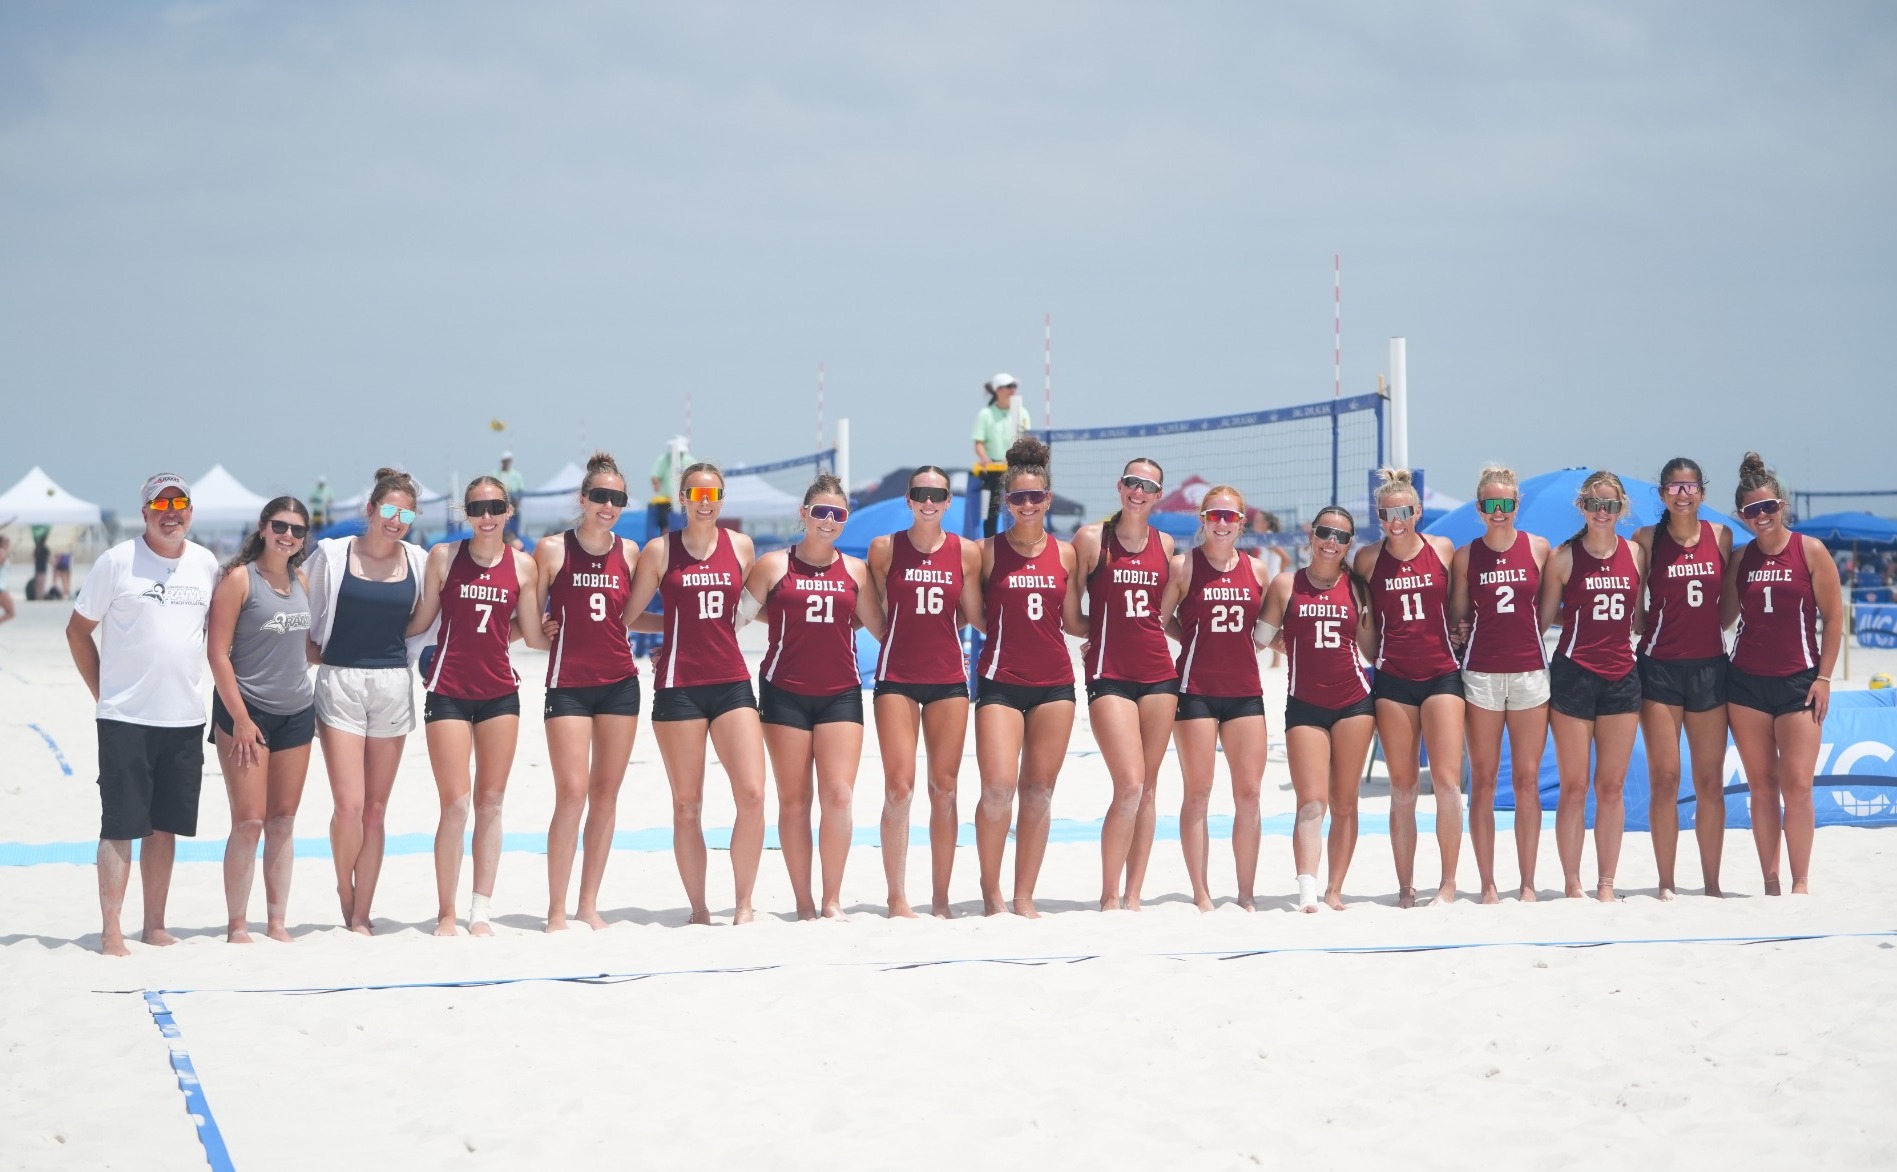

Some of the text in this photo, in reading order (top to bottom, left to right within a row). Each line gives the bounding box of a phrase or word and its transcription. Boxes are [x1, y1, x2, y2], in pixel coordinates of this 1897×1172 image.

[681, 573, 732, 586] MOBILE
[904, 569, 953, 584] MOBILE
[1113, 570, 1159, 585] MOBILE
[1479, 569, 1528, 585] MOBILE
[1667, 562, 1715, 577] MOBILE
[1746, 569, 1793, 582] MOBILE
[572, 573, 620, 589] MOBILE
[795, 579, 846, 592] MOBILE
[1007, 575, 1057, 588] MOBILE
[1384, 574, 1434, 590] MOBILE
[1584, 577, 1631, 590] MOBILE
[459, 584, 509, 603] MOBILE
[916, 587, 943, 614] 16
[1125, 590, 1150, 617] 12
[1202, 588, 1252, 600] MOBILE
[1496, 586, 1514, 613] 2
[1687, 580, 1703, 607] 6
[1763, 587, 1773, 612] 1
[590, 593, 606, 621] 9
[698, 591, 724, 619] 18
[806, 595, 834, 623] 21
[1028, 593, 1043, 620] 8
[1298, 604, 1349, 619] MOBILE
[1400, 593, 1425, 621] 11
[1593, 593, 1625, 620] 26
[475, 604, 492, 633] 7
[1212, 605, 1244, 632] 23
[1315, 621, 1341, 648] 15
